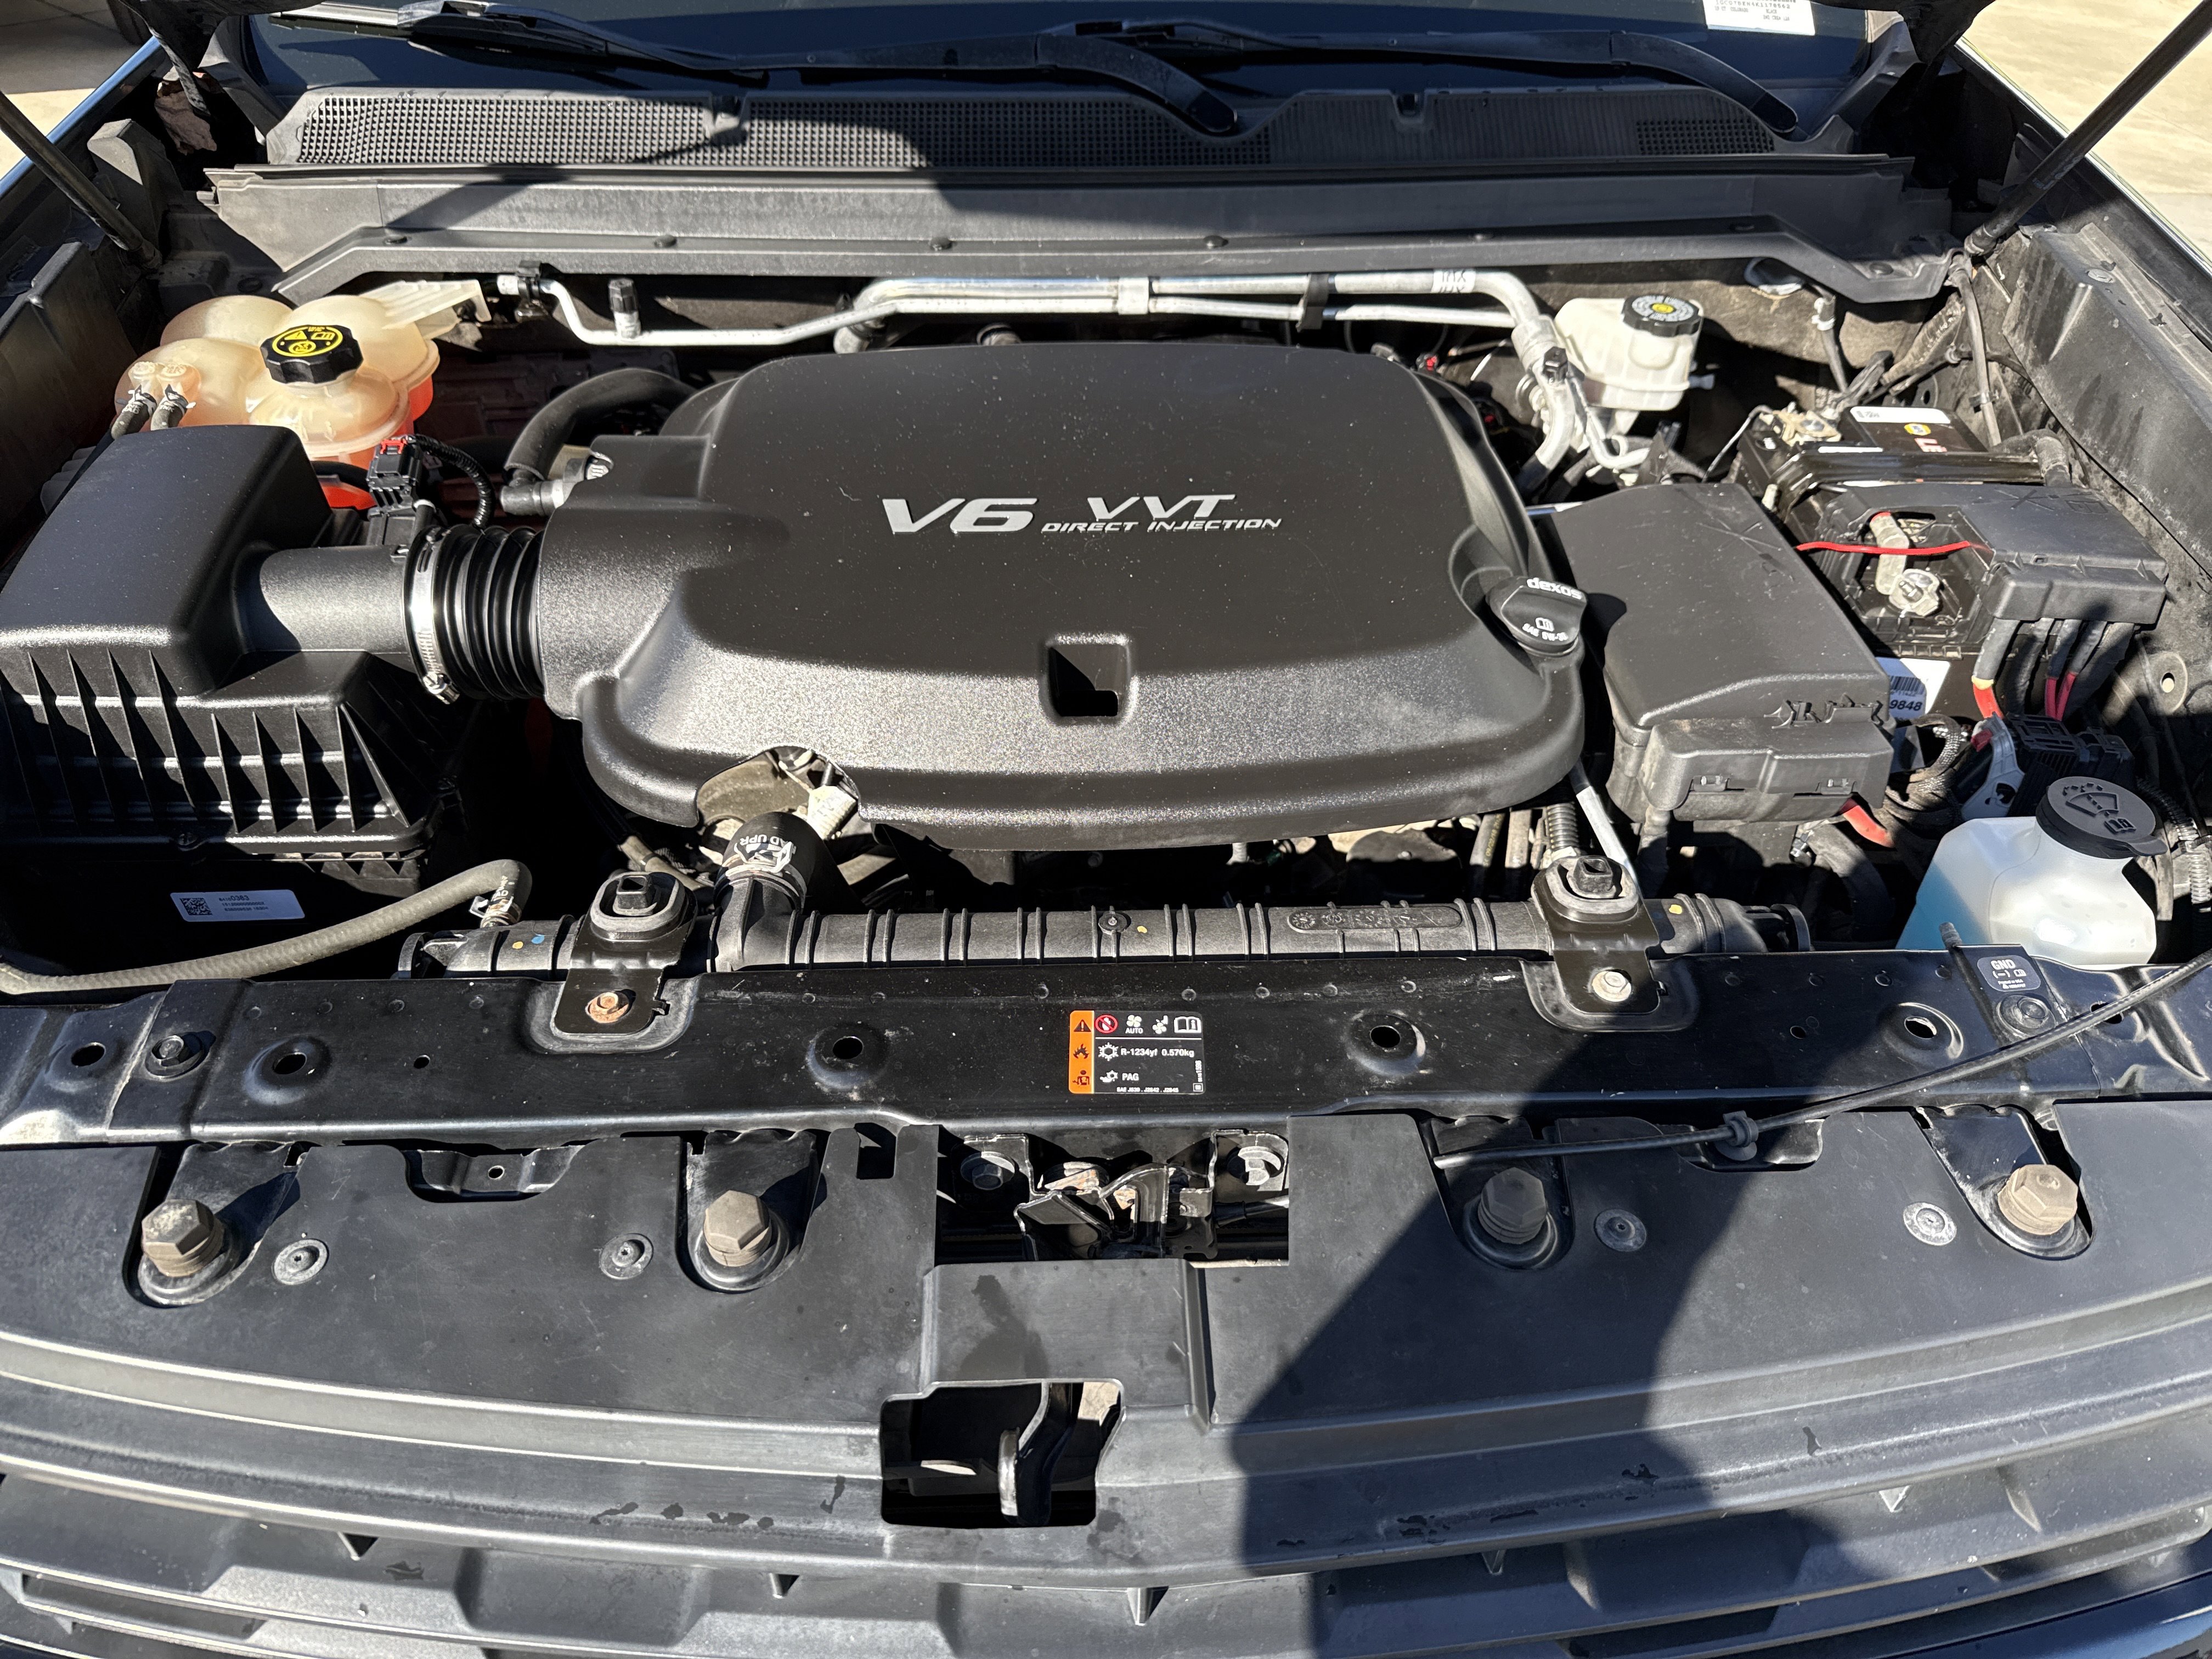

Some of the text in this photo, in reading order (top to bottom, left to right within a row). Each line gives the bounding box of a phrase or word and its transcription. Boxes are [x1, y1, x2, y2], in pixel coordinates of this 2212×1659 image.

[882, 494, 1235, 534] V6 VVT
[1041, 518, 1282, 533] DIRECT INJECTION
[1527, 577, 1582, 600] dexos
[1522, 623, 1540, 637] SAE
[1889, 699, 1922, 711] 9848
[740, 834, 768, 846] UPR
[1990, 959, 2016, 970] GND
[1120, 1048, 1194, 1058] R-1234yf 0.570kg
